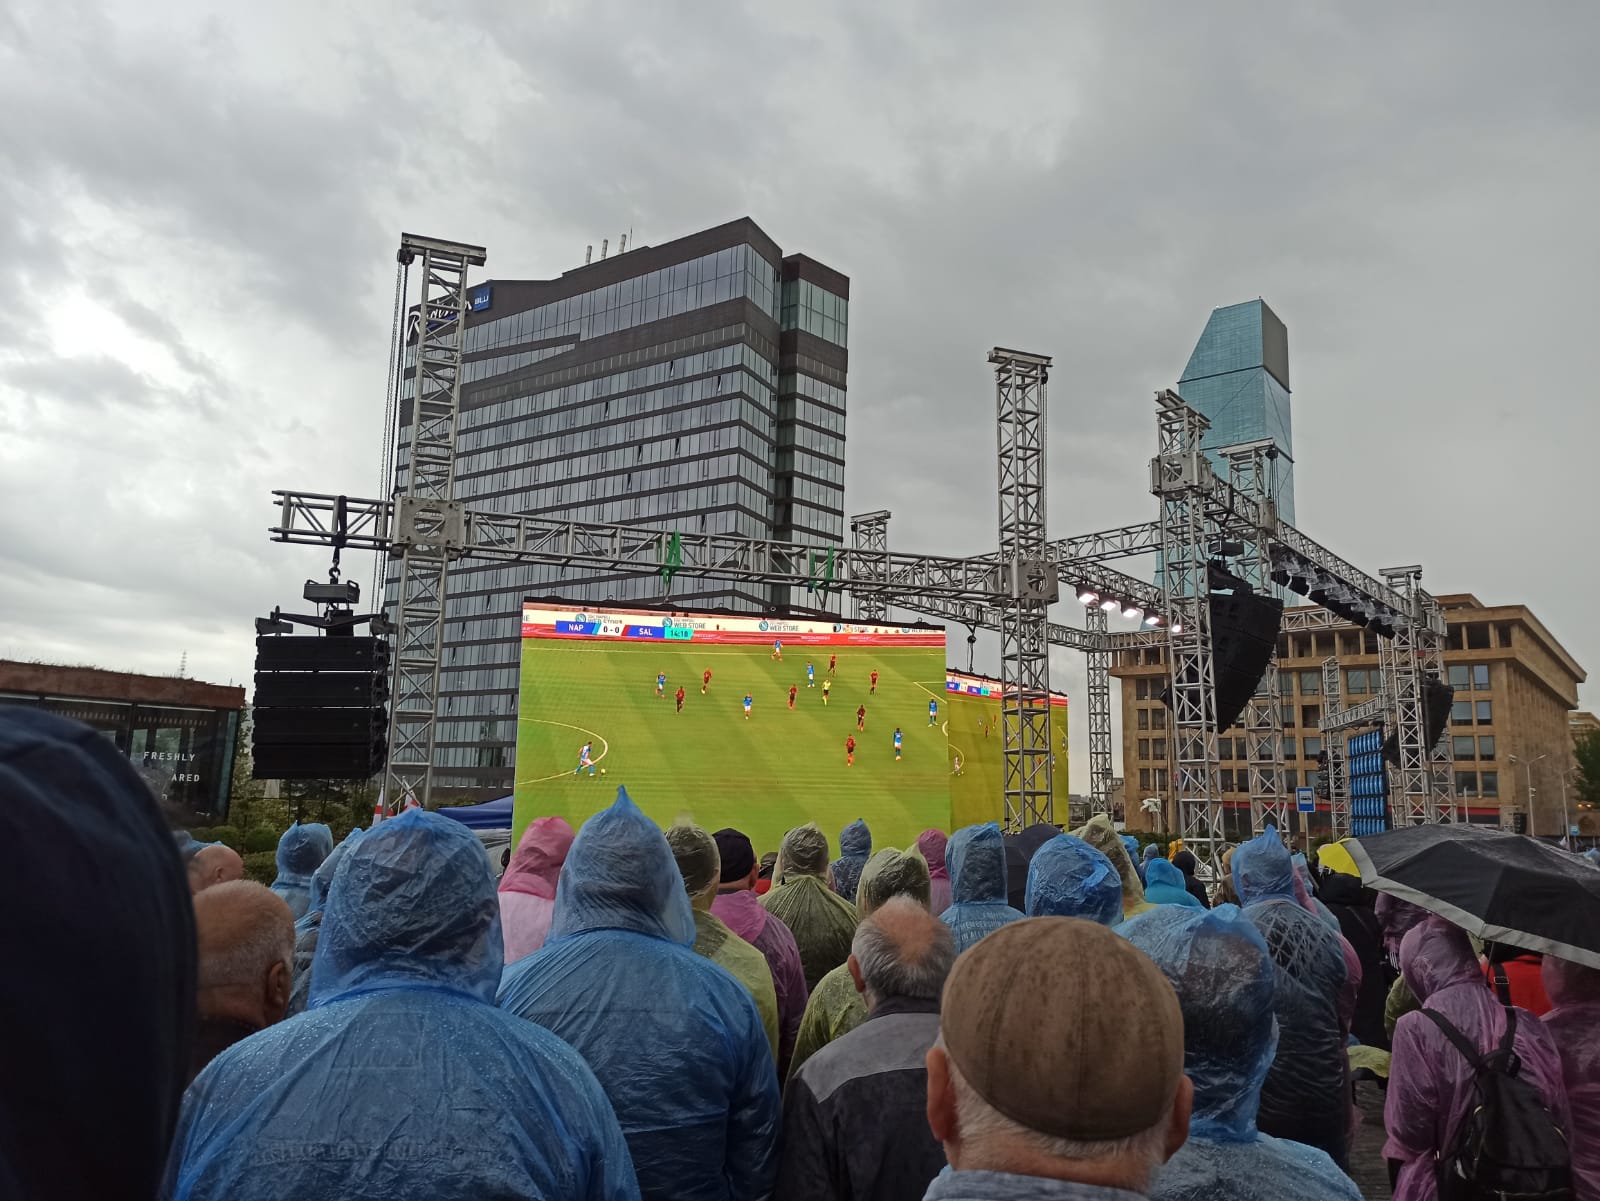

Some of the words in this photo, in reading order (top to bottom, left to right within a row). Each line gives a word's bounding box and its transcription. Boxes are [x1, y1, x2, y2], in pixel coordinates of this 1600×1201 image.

[568, 623, 584, 632] NAP
[639, 627, 653, 636] SAL
[143, 751, 196, 762] FRESHLY
